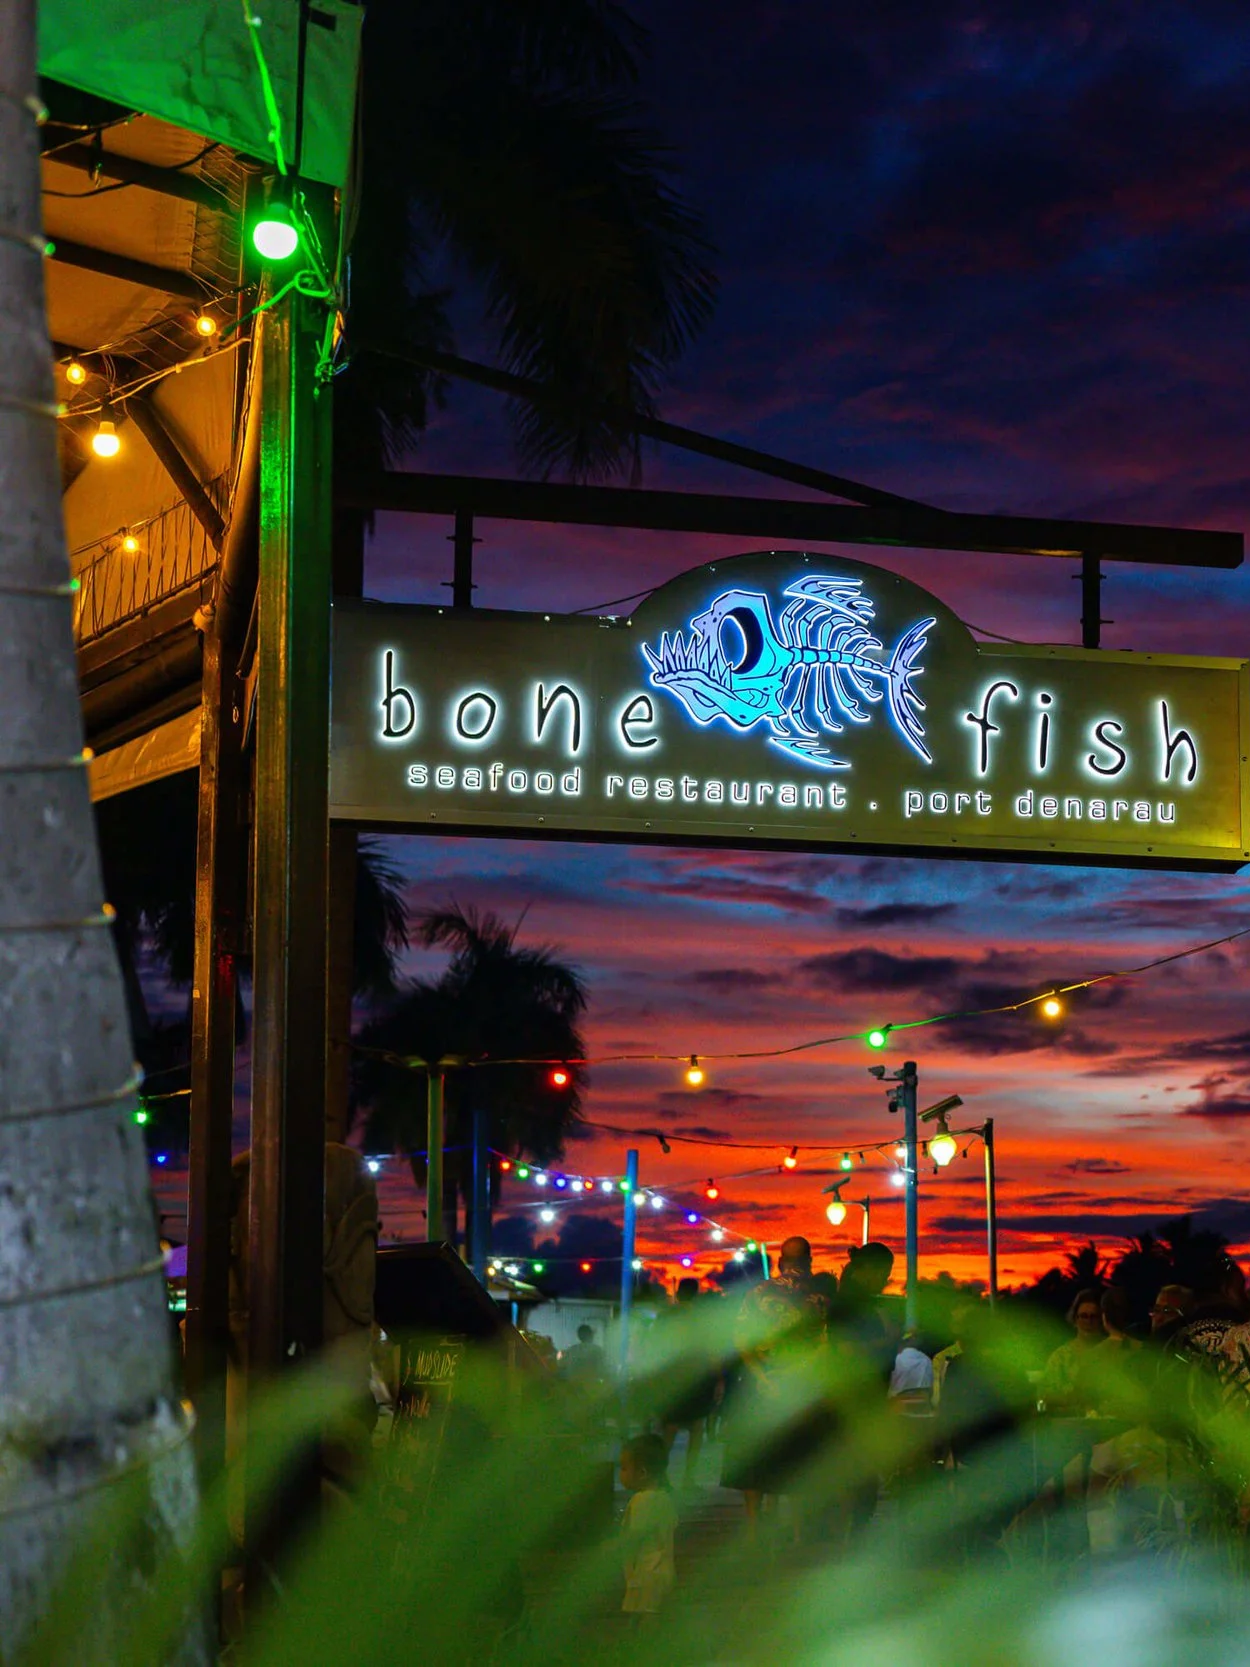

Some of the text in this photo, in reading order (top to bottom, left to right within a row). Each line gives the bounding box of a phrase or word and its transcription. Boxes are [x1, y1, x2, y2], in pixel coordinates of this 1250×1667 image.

[380, 648, 1200, 786] bone fish
[407, 762, 582, 796] seafood
[606, 771, 847, 811] restaurant
[906, 789, 993, 818] port
[1016, 789, 1177, 823] denarau
